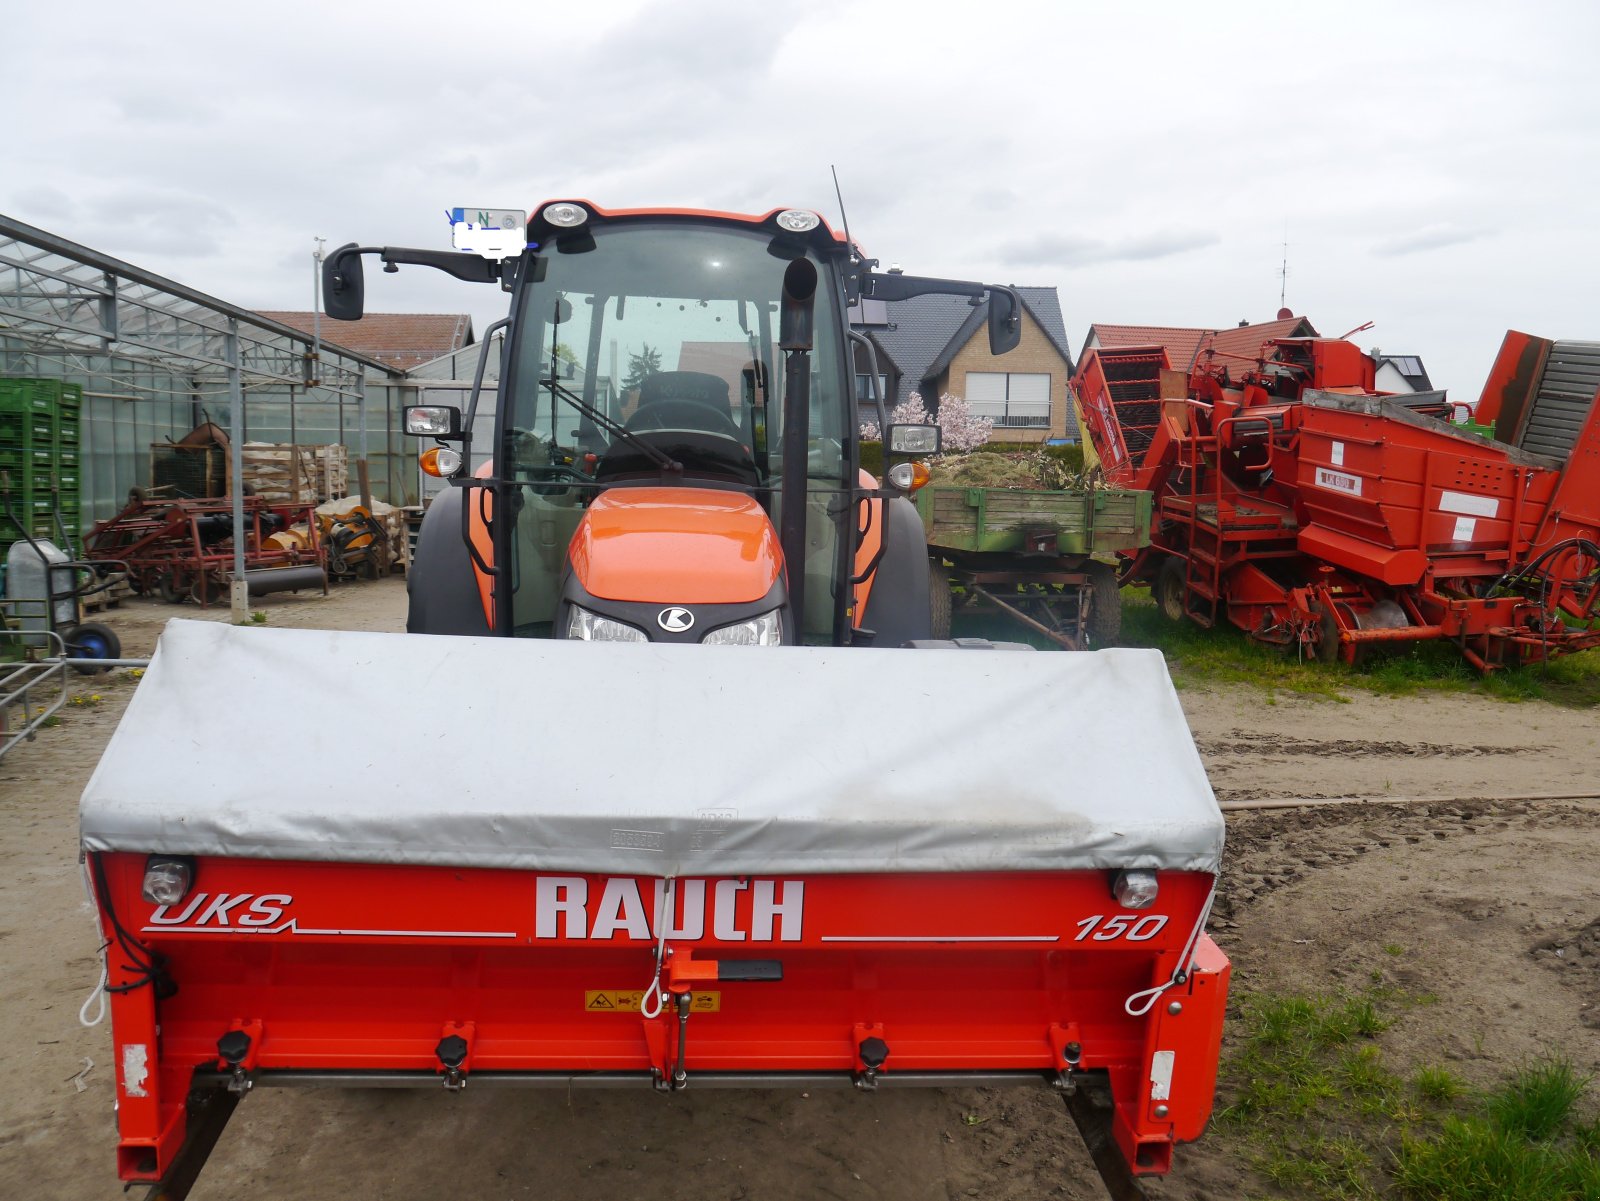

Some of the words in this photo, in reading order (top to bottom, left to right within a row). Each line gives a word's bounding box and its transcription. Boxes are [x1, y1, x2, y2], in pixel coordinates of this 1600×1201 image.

[478, 211, 489, 228] N
[150, 893, 293, 926] UKS
[536, 876, 804, 941] RAUCH
[1074, 914, 1169, 941] 150
